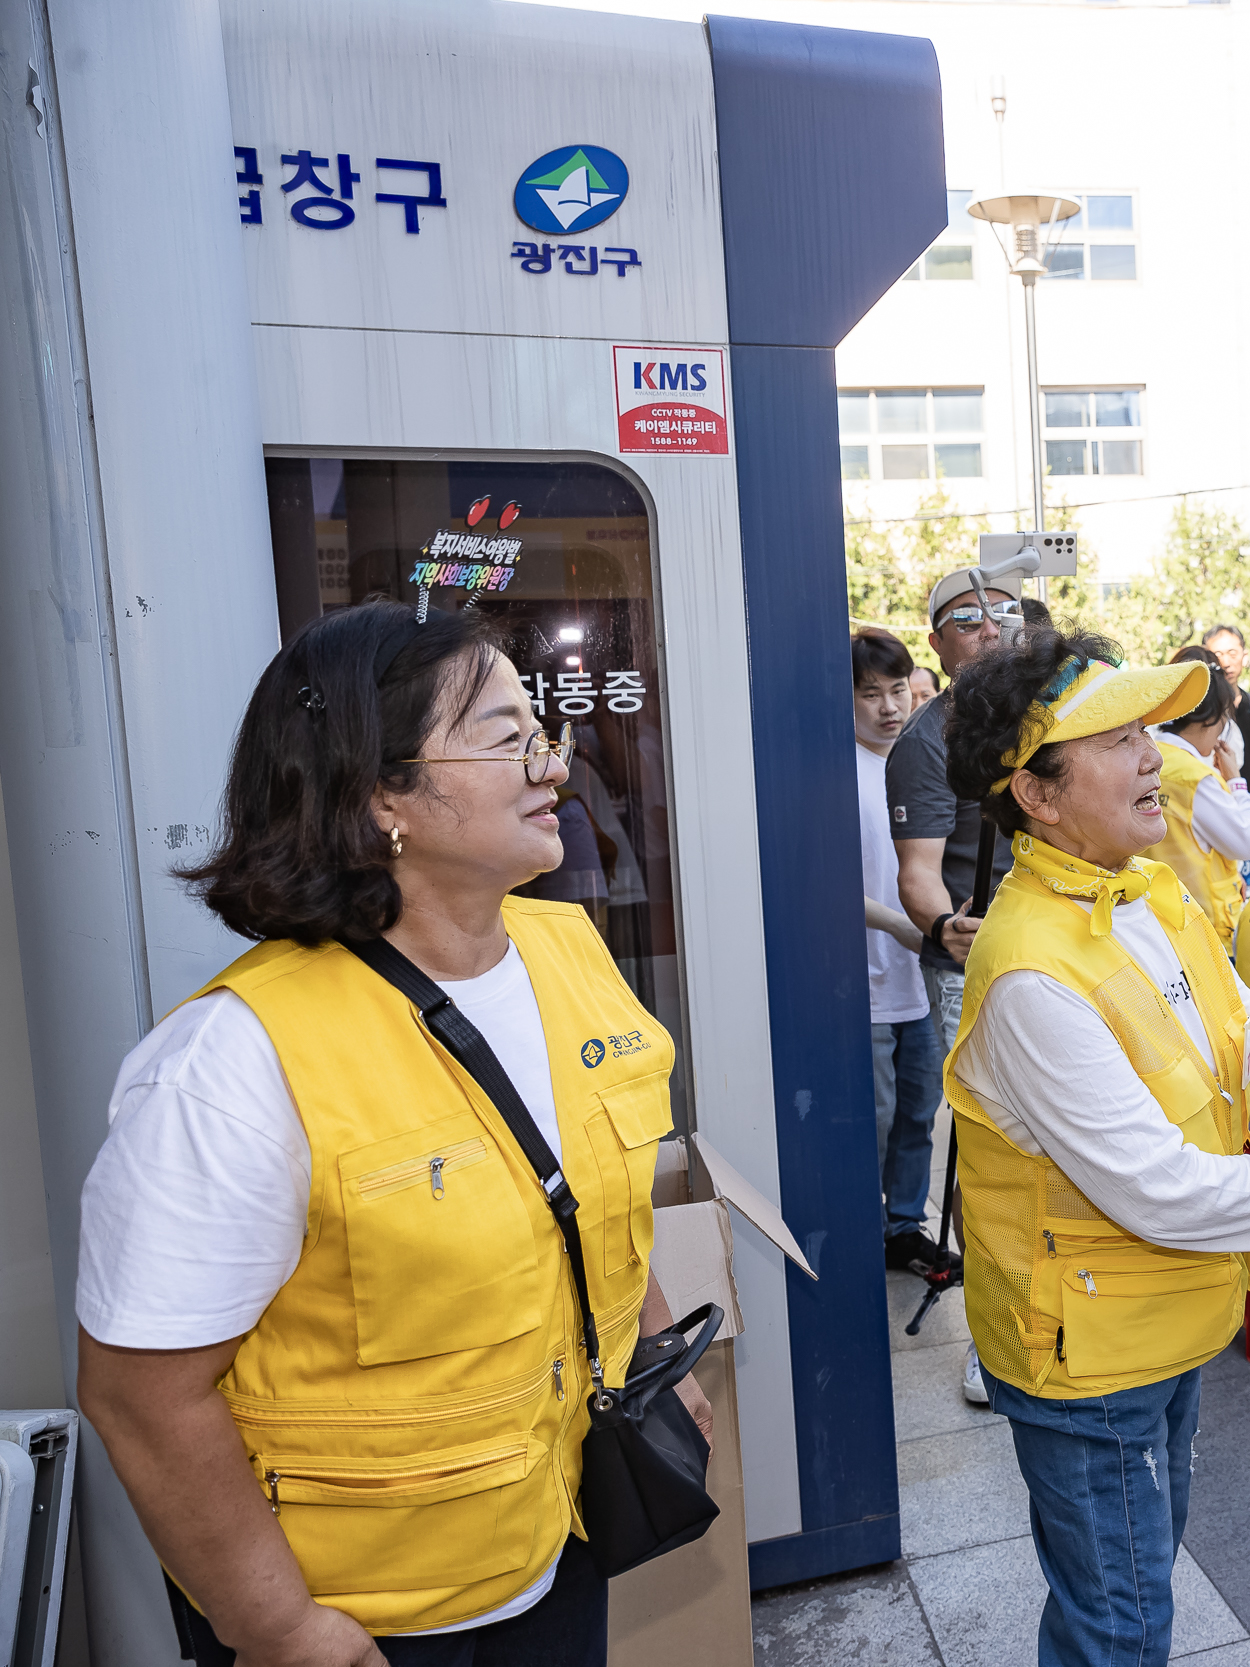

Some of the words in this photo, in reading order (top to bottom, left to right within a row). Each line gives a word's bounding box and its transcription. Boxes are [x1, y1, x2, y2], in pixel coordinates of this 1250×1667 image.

[511, 241, 642, 277] 광진구
[633, 362, 707, 391] KMS
[651, 408, 673, 417] CCTV
[674, 409, 696, 418] 작동중
[634, 420, 716, 434] 케이엠시큐리티
[651, 437, 697, 445] 1588-1149
[607, 1030, 643, 1050] 광진구
